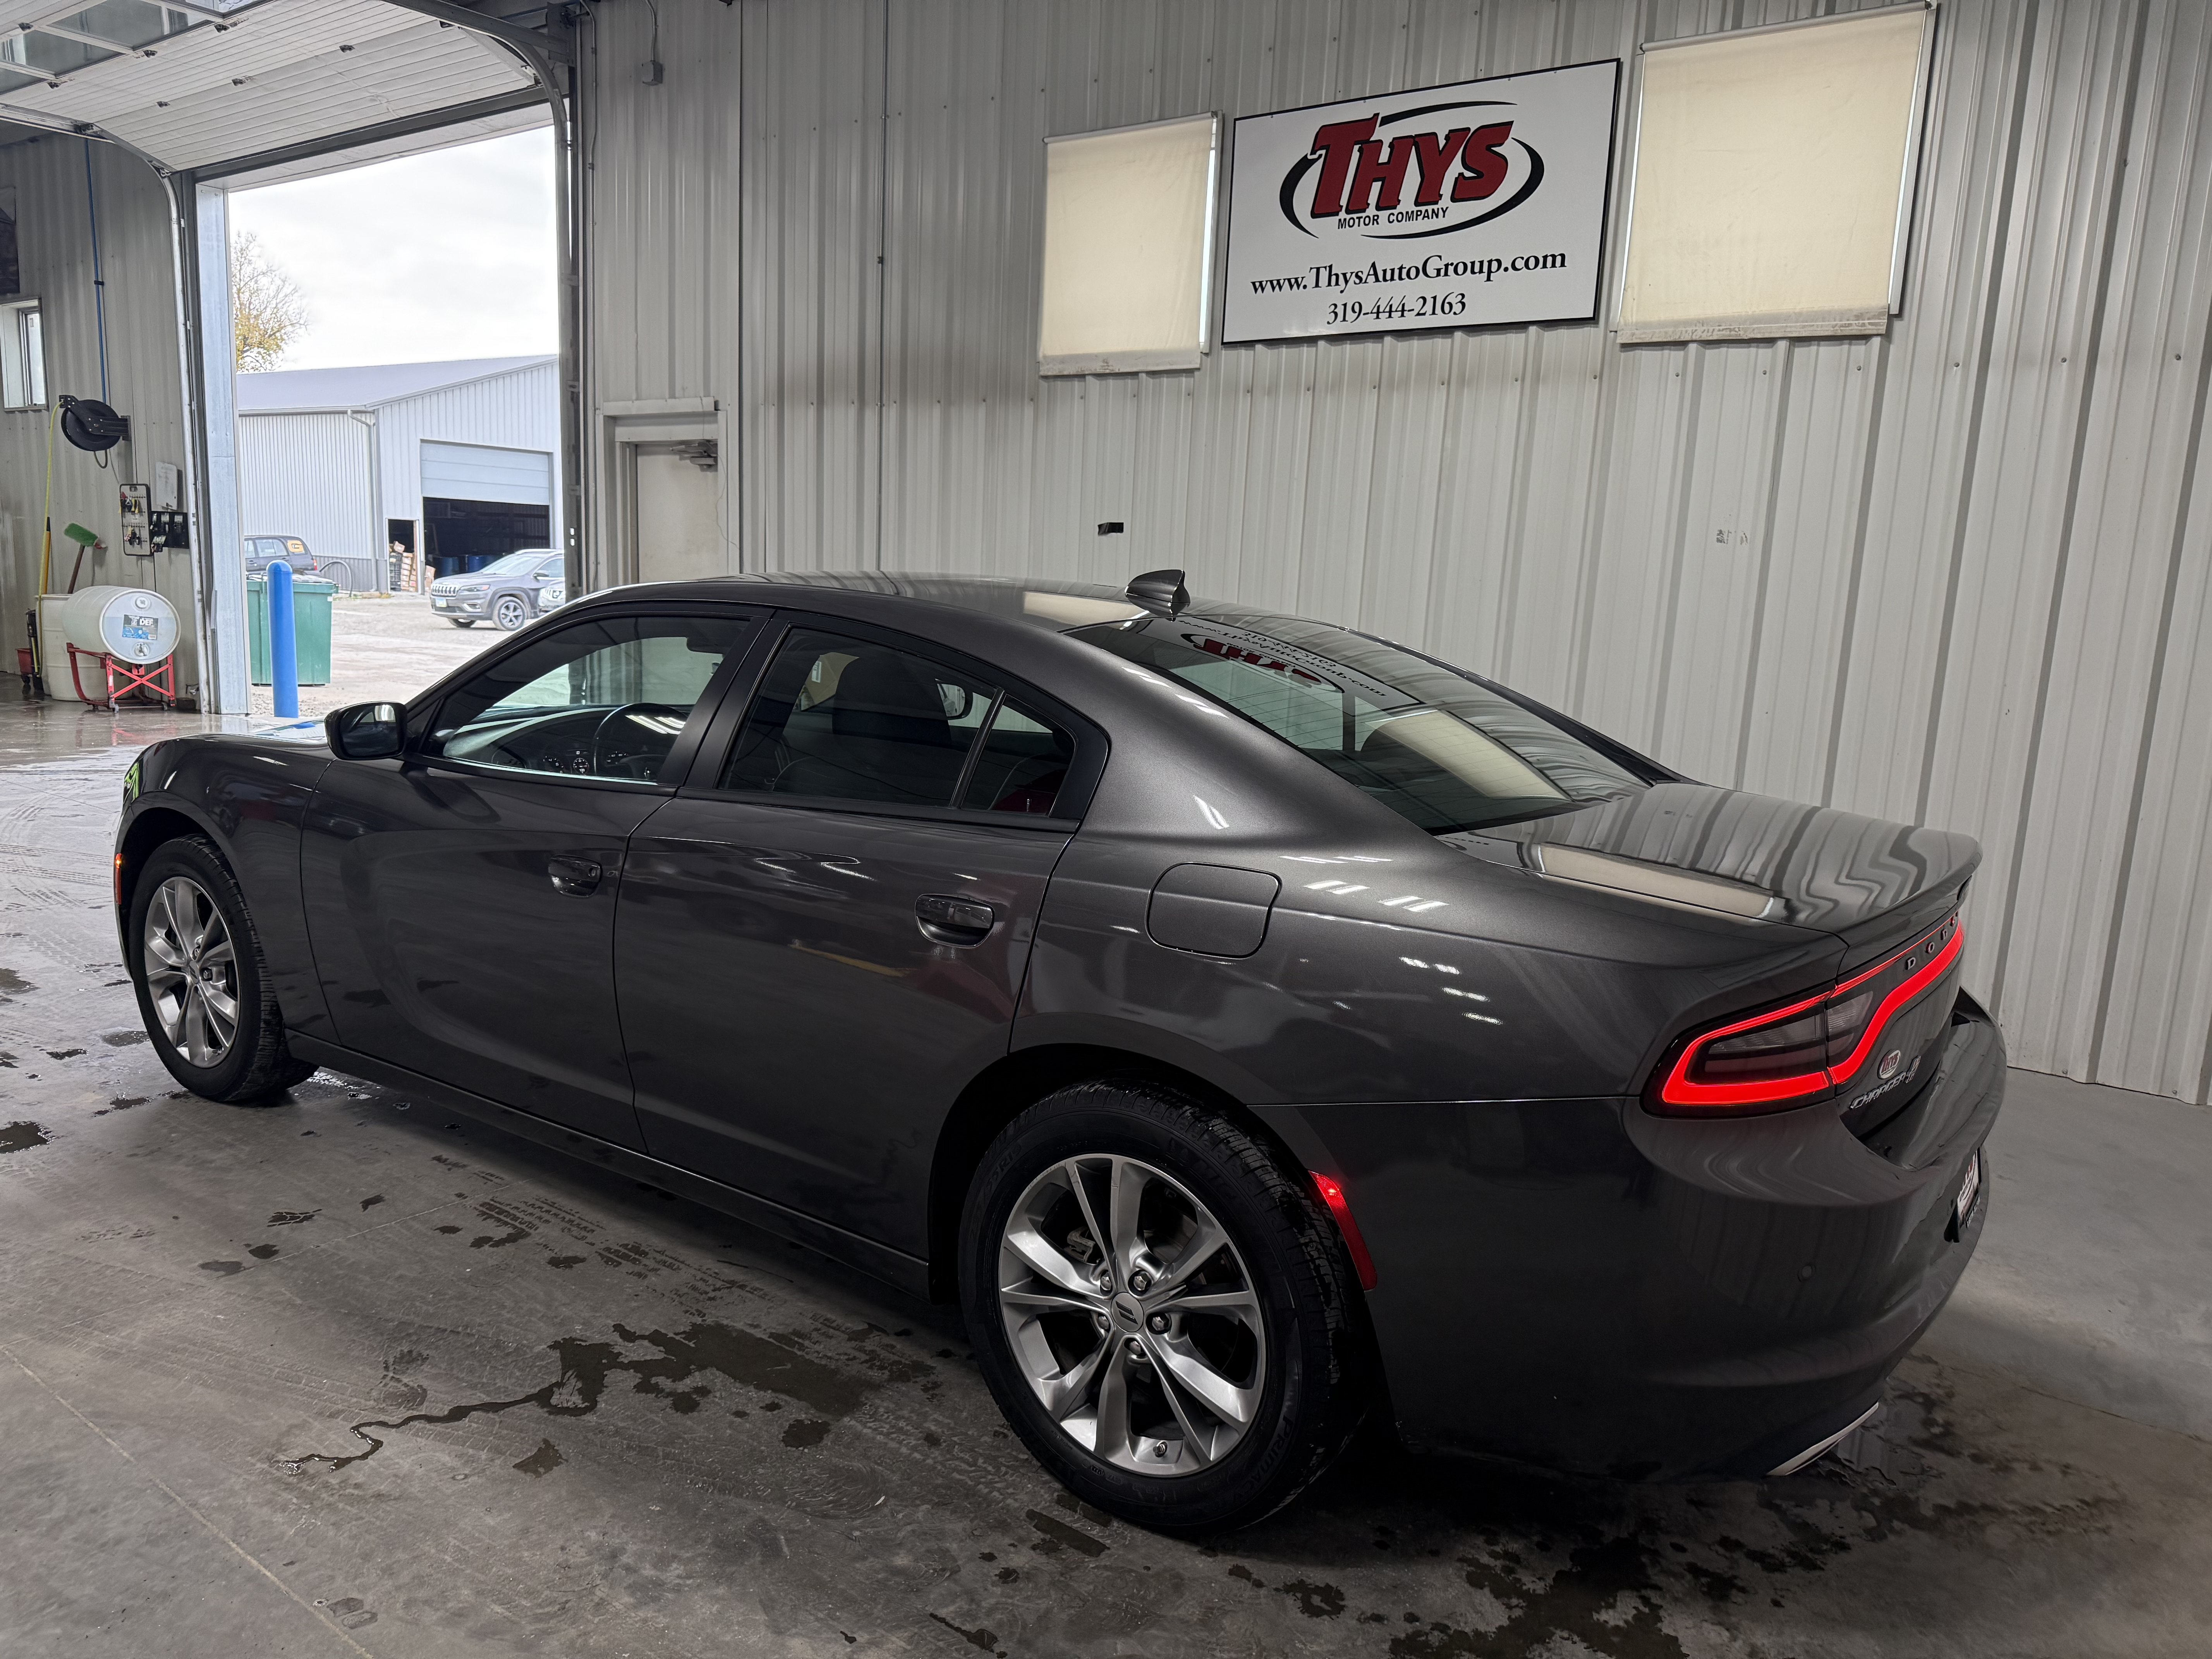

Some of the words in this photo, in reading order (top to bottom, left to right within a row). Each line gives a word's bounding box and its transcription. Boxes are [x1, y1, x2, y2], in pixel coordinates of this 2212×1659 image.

[1310, 112, 1514, 219] THYS
[1338, 214, 1380, 230] MOTOR
[1387, 206, 1449, 224] COMPANY
[1250, 253, 1567, 294] www.ThysAutoGroup.com
[1327, 292, 1466, 325] 319-444-2163
[1849, 1071, 1907, 1109] CHARGER
